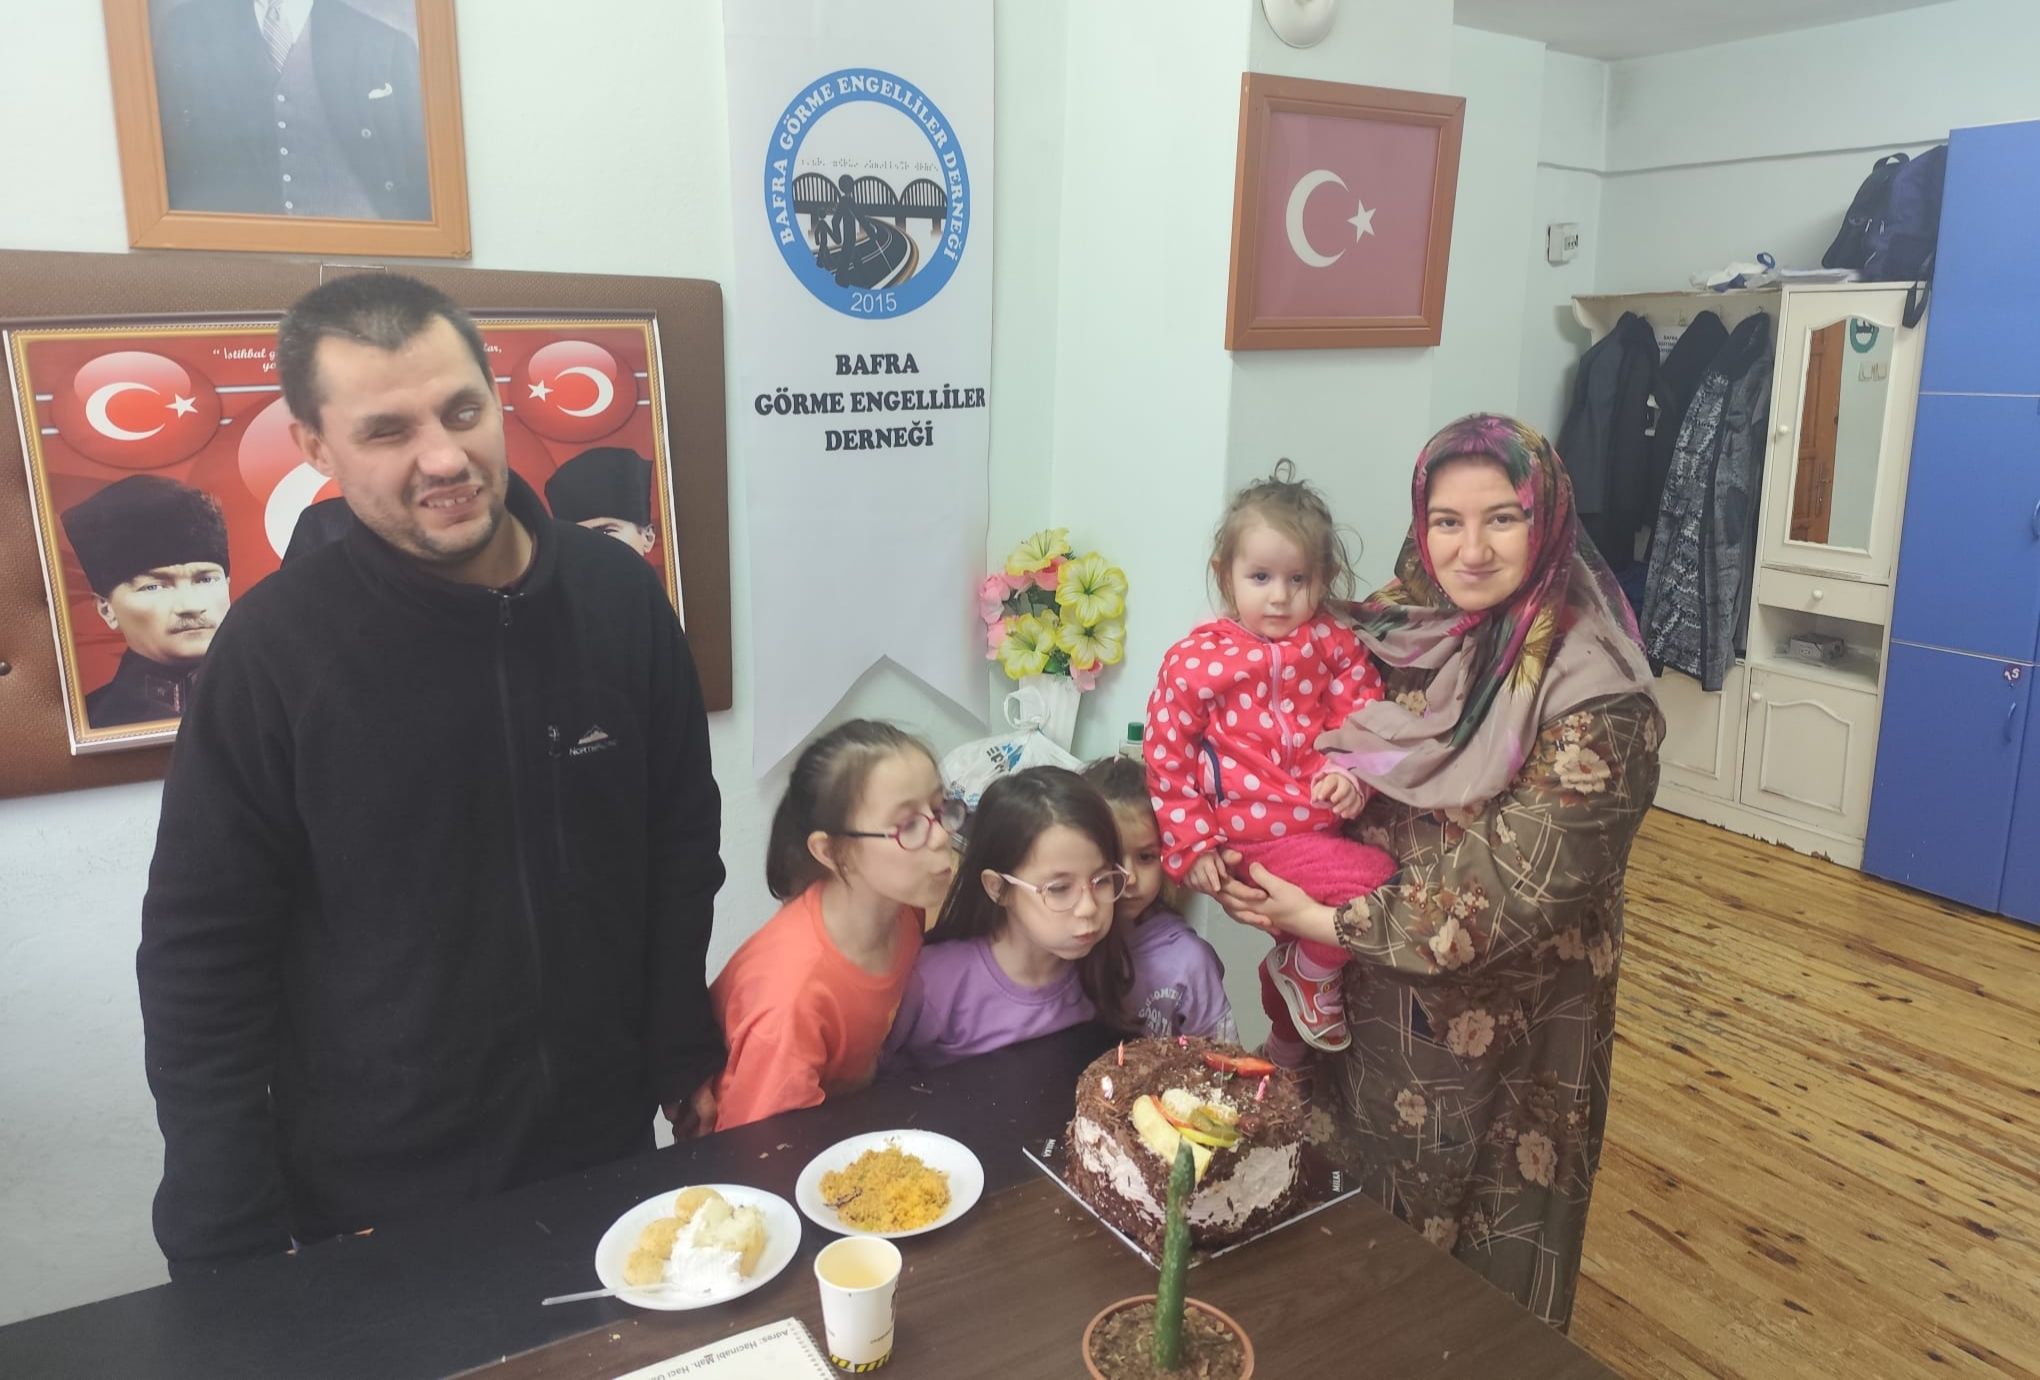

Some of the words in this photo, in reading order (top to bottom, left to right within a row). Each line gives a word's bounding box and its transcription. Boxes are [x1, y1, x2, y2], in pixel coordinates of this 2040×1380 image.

[779, 82, 835, 150] GÖRME
[837, 75, 948, 149] ENGELLİLER
[772, 158, 796, 246] BAFRA
[943, 150, 964, 262] DERNEĞİ
[850, 292, 897, 313] 2015
[835, 352, 920, 376] BAFRA
[754, 387, 846, 416] GÖRME
[850, 383, 986, 413] ENGELLİLER
[824, 420, 934, 452] DERNEĞİ
